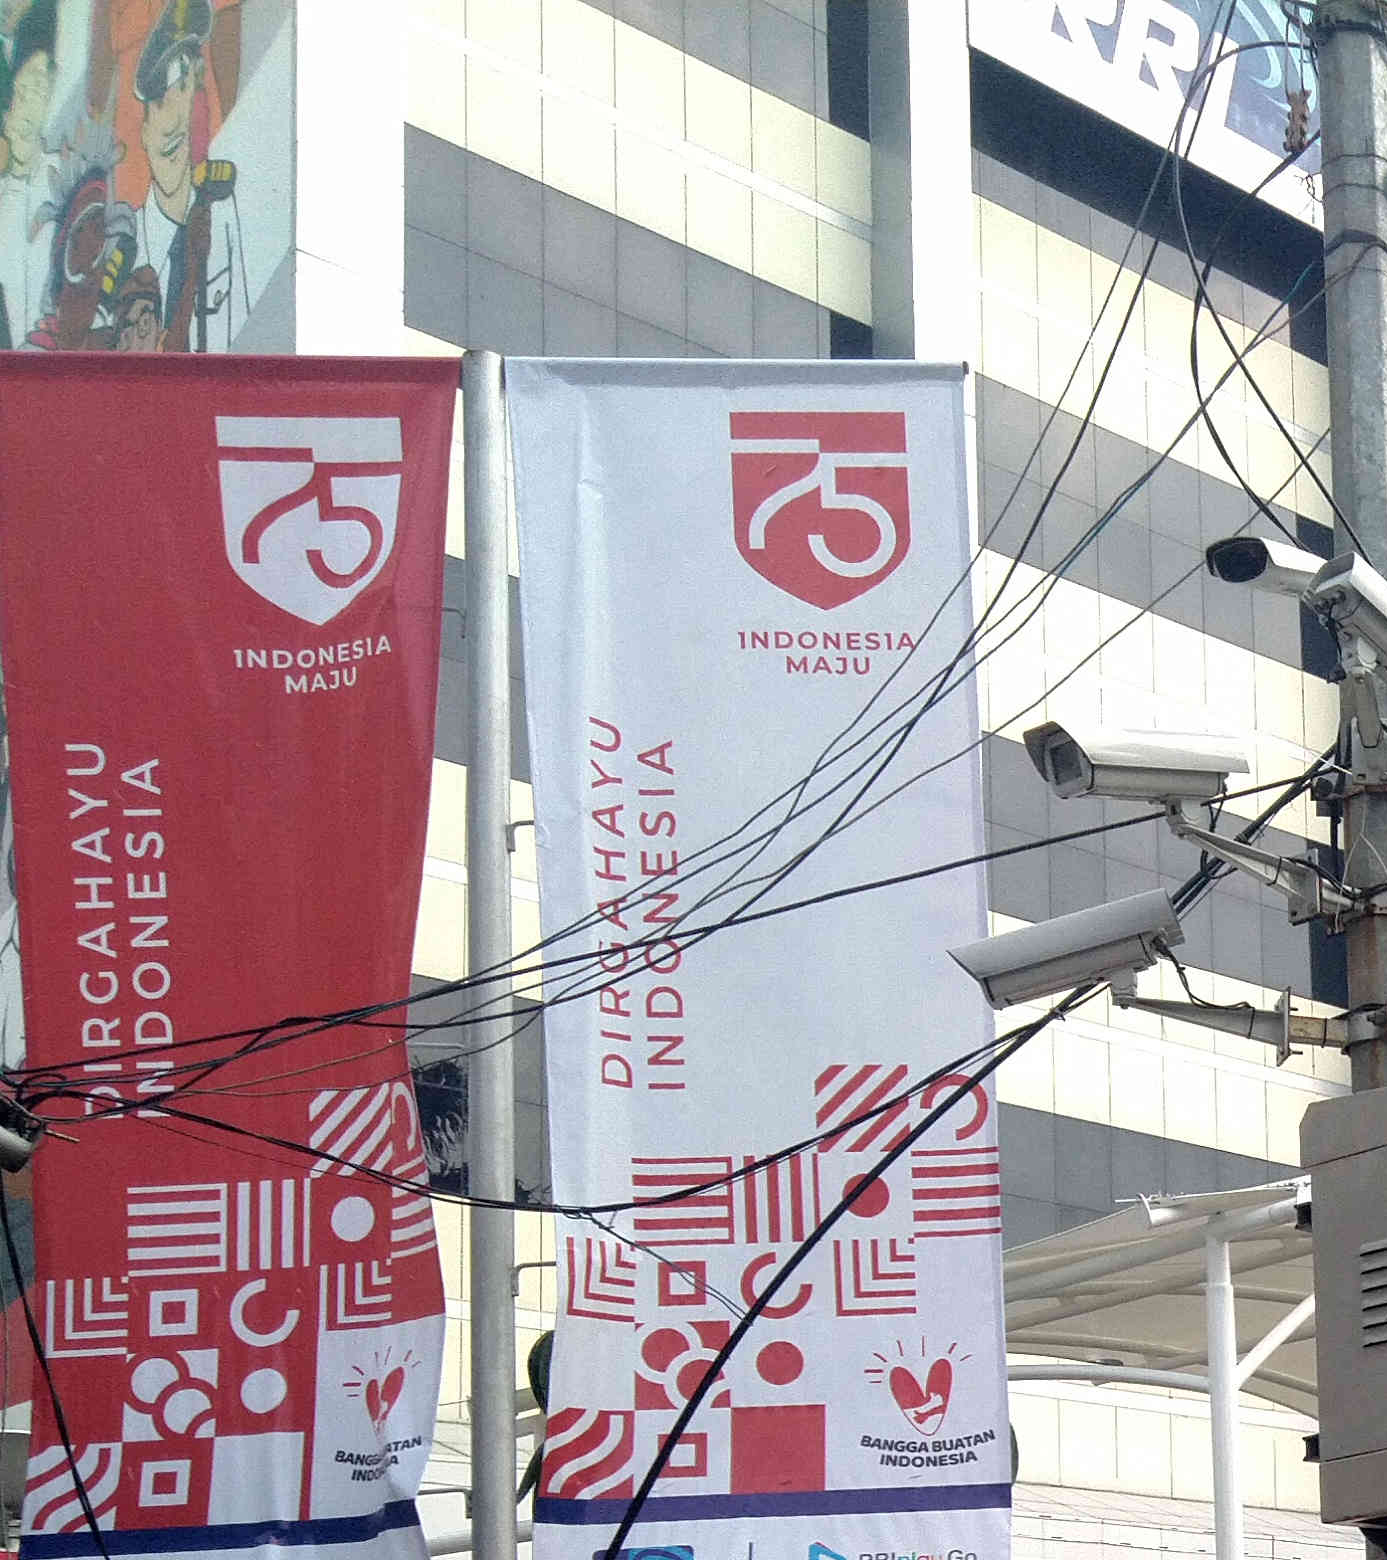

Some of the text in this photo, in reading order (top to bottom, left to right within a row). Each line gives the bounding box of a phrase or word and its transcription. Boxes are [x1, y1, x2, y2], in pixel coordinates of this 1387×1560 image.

[233, 635, 392, 669] INDONESIA
[738, 631, 916, 650] INDONESIA
[285, 666, 358, 694] MAJU
[786, 655, 871, 675] MAJU
[590, 715, 634, 1088] DIRGAHAYU
[638, 739, 685, 1090] INDONESIA
[64, 741, 124, 1120] DIRGAHAYU
[121, 757, 176, 1118] INDONESIA
[860, 1429, 996, 1453] BANGGA BUATAN
[880, 1450, 978, 1468] INDONESIA
